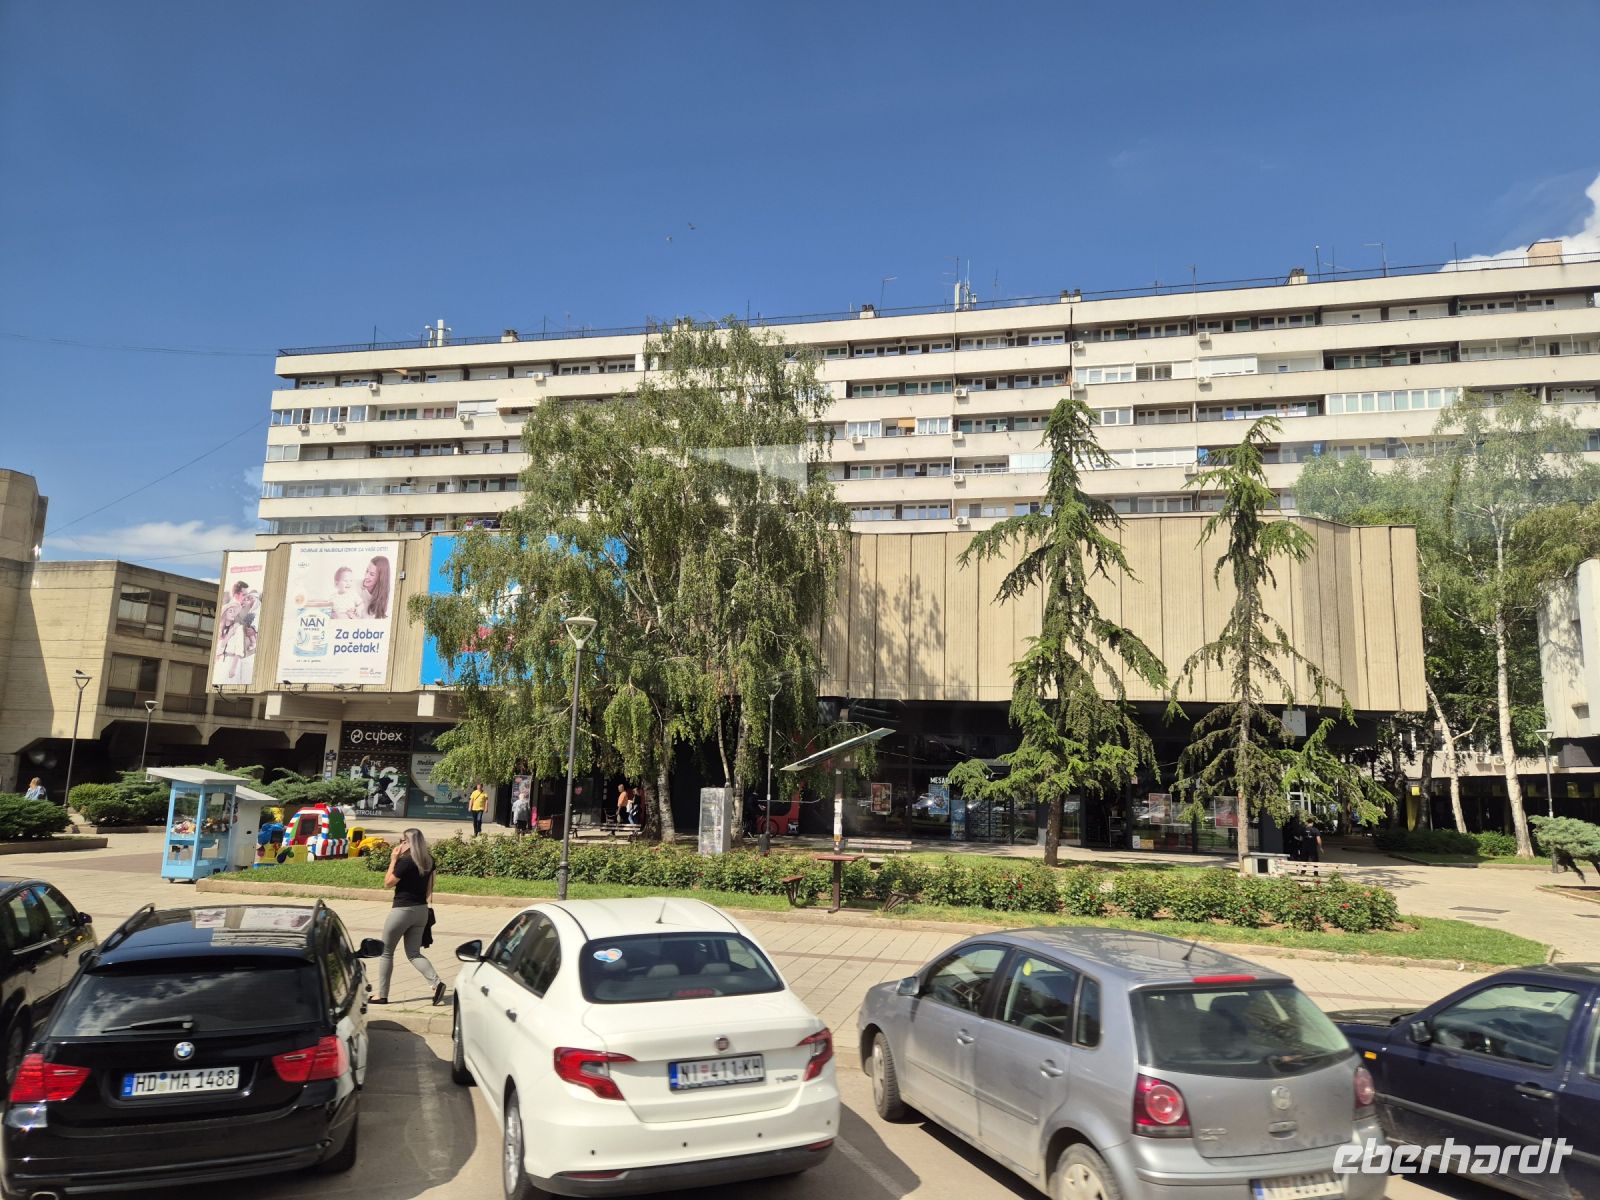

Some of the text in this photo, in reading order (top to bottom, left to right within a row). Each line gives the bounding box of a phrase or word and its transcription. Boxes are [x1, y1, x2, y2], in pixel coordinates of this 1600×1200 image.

[300, 617, 325, 627] NAN
[335, 628, 384, 640] Za dobar
[333, 642, 379, 656] početak!
[365, 729, 402, 744] cybex
[680, 1064, 697, 1083] NI
[135, 1069, 236, 1093] HD MA 1488
